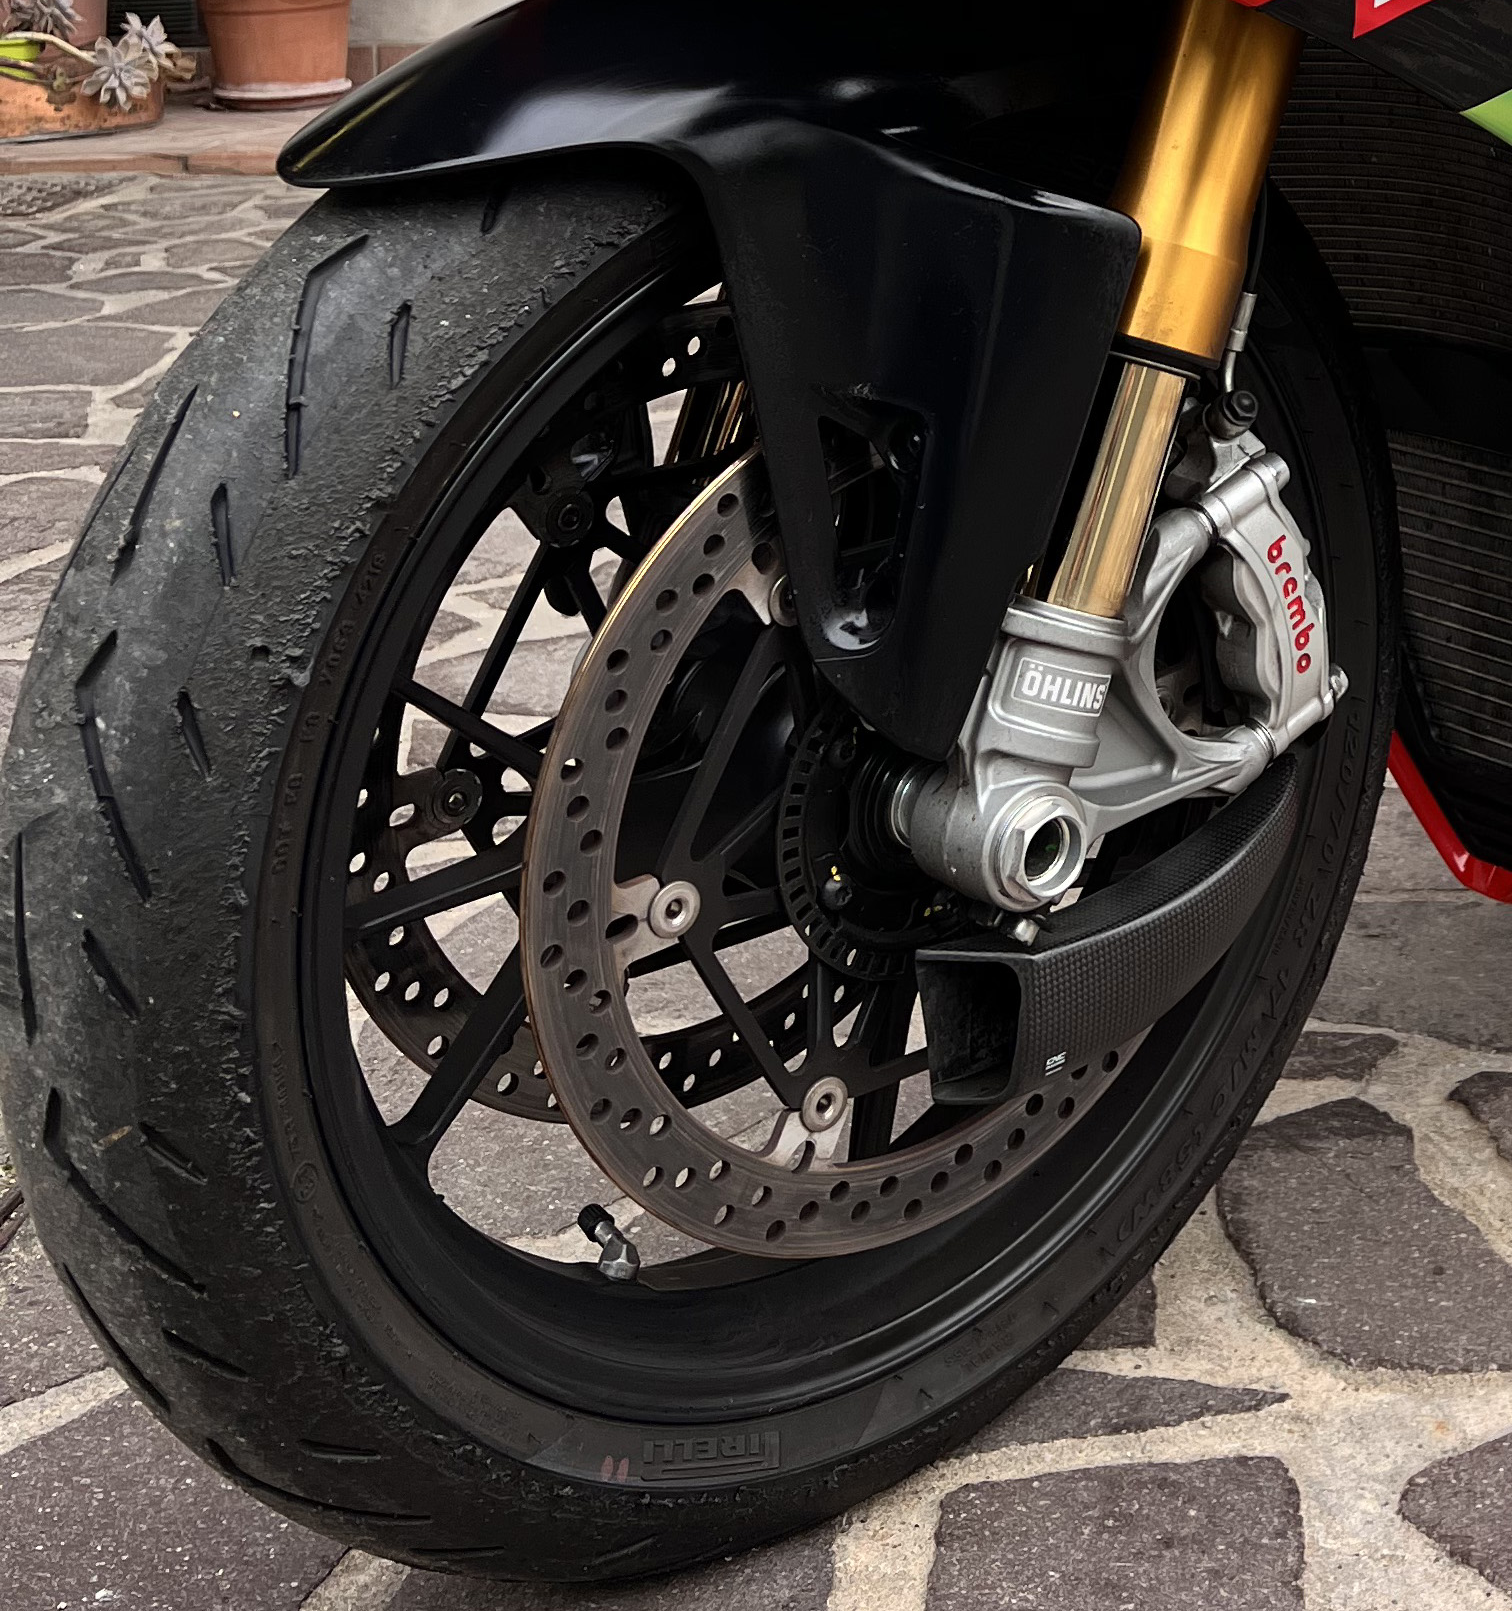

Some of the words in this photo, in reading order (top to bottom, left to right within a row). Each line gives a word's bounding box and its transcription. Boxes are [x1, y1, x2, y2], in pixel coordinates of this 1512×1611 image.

[1267, 534, 1315, 674] brembo
[1021, 663, 1106, 710] ÖHLINS
[640, 1430, 781, 1482] PIRELLI
